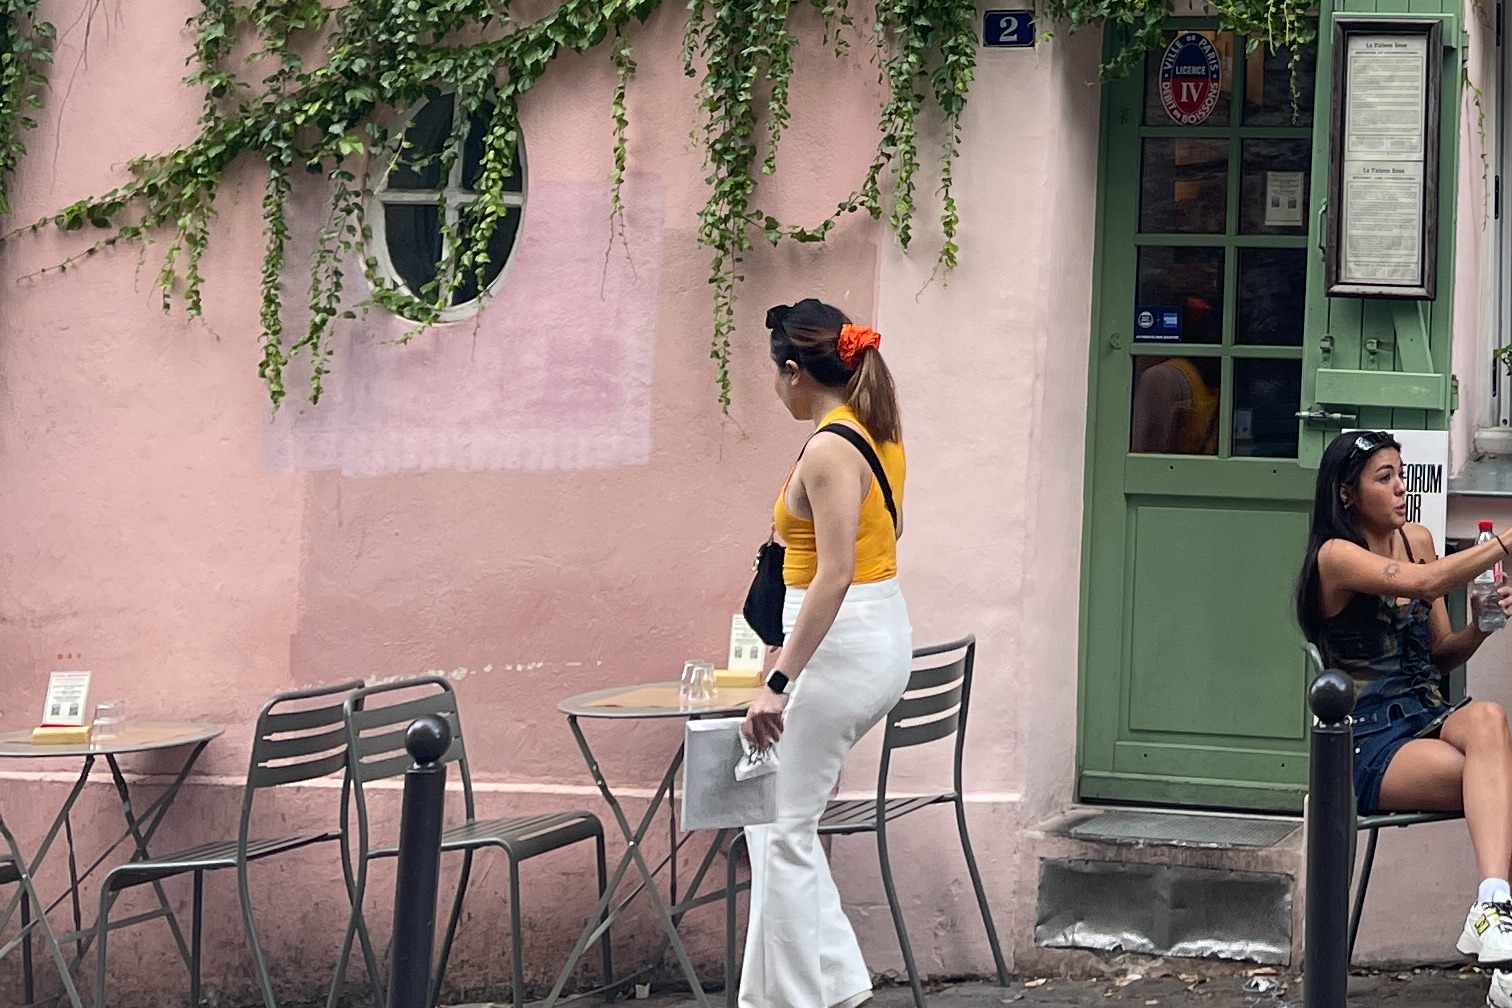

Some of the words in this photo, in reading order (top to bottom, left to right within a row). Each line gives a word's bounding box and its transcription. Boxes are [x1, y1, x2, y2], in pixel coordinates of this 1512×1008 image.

[998, 16, 1019, 42] 2
[1164, 40, 1184, 70] VILLE
[1198, 38, 1219, 72] PARIS
[1175, 65, 1206, 75] LICENCE
[1180, 82, 1204, 103] IV
[1181, 82, 1219, 124] BOISSONS
[1474, 914, 1490, 937] N
